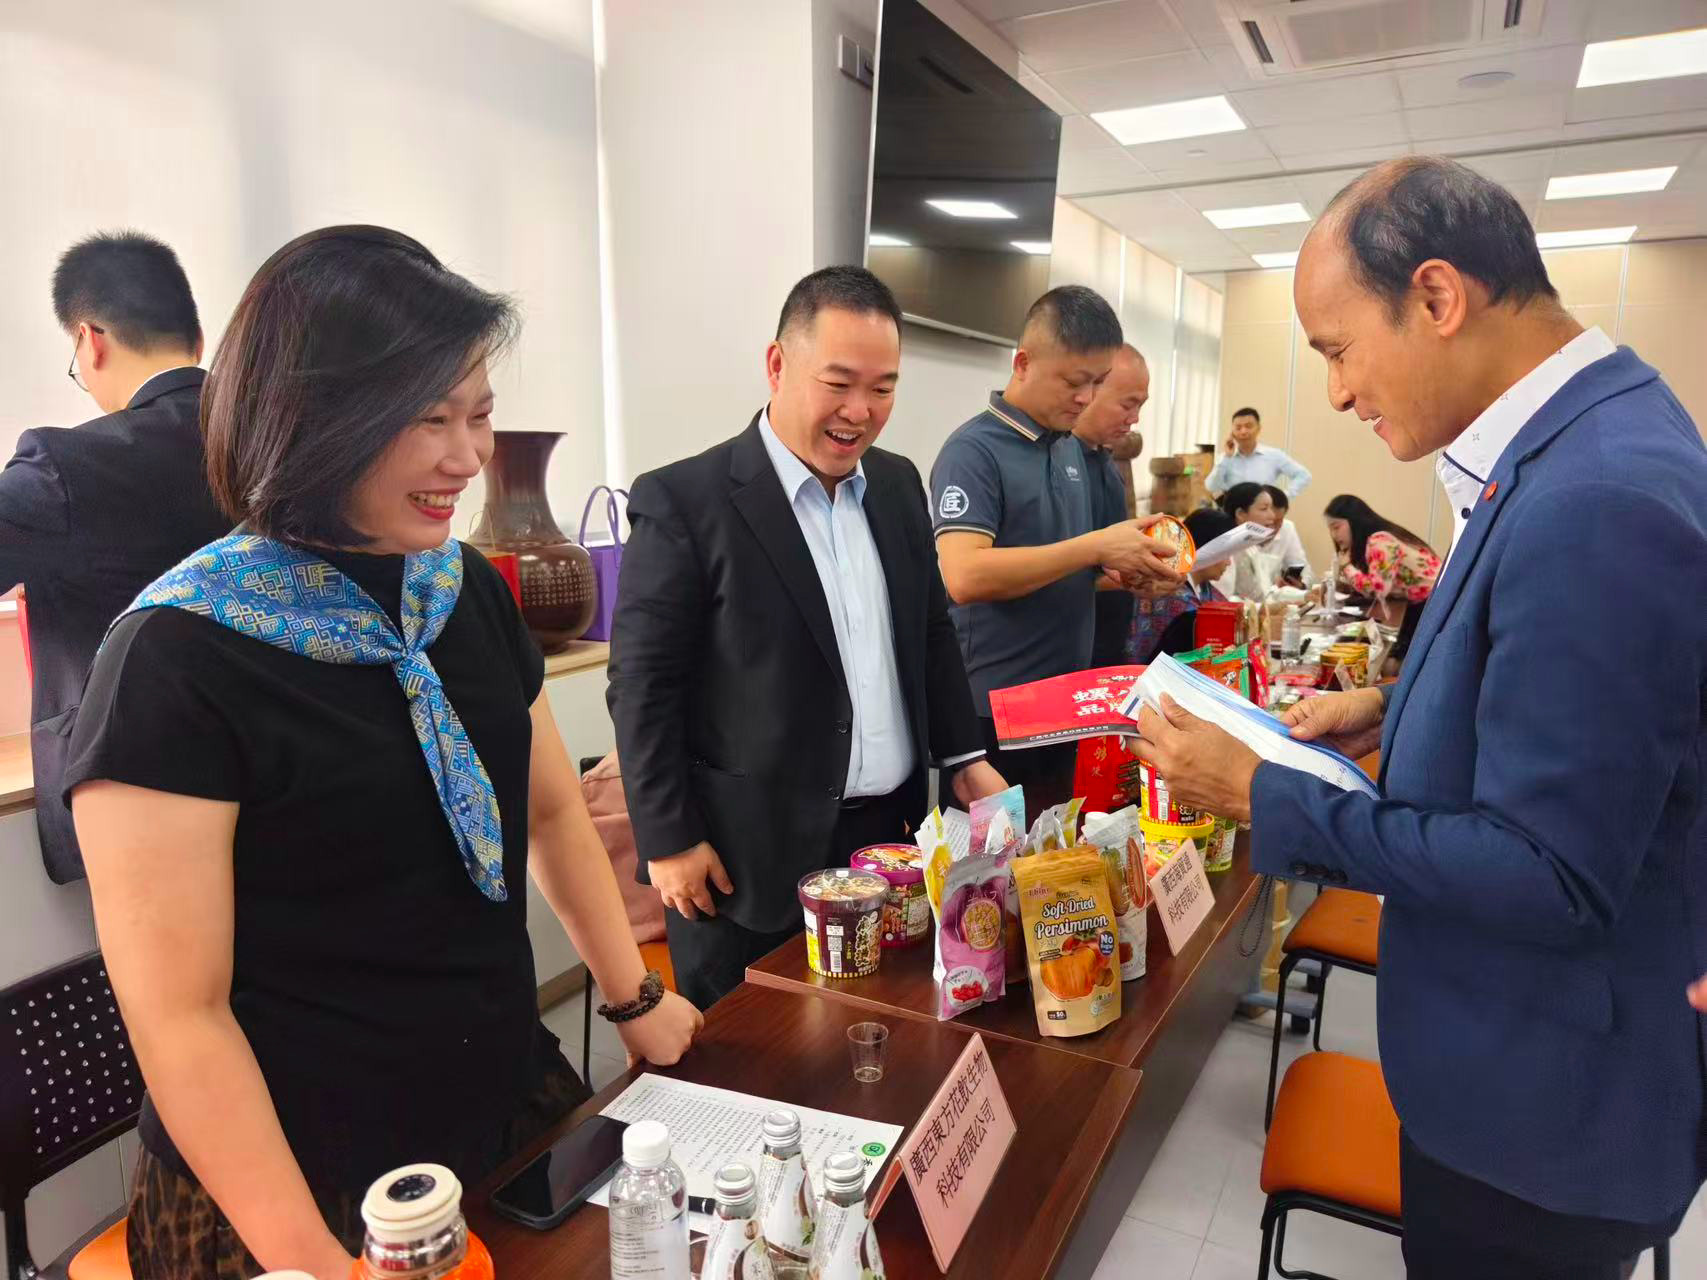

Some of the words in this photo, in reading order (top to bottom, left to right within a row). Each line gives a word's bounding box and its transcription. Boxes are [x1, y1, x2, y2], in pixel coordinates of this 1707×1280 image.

[1042, 900, 1066, 919] Soft
[1067, 896, 1096, 914] Dried
[1035, 914, 1109, 940] Persimmon
[1100, 933, 1114, 944] No
[909, 1050, 988, 1186] 廣西東方花飲生物
[936, 1097, 996, 1208] 科技有限公司
